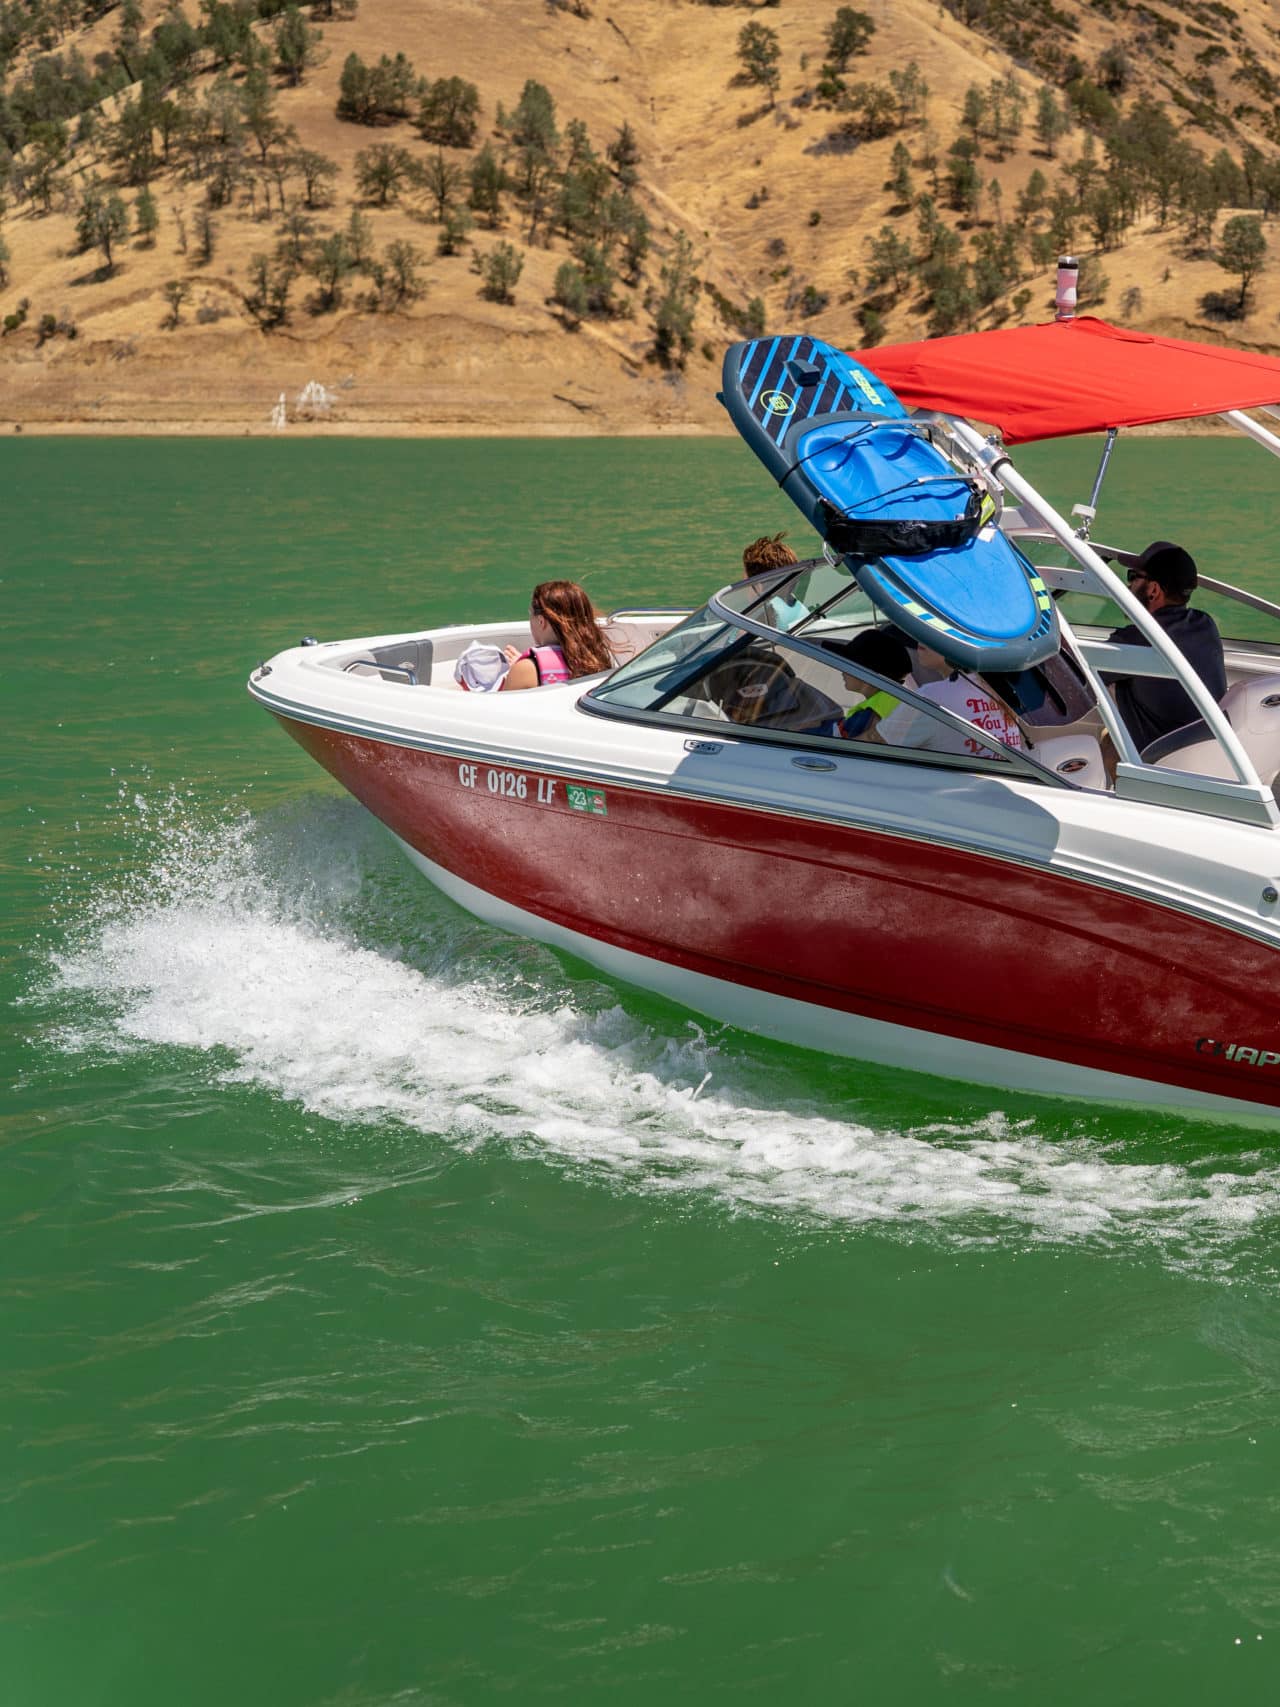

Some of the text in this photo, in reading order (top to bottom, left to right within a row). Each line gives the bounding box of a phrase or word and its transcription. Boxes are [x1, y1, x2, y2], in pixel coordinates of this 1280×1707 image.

[459, 763, 557, 804] CF 0126 LF
[573, 790, 587, 806] 23
